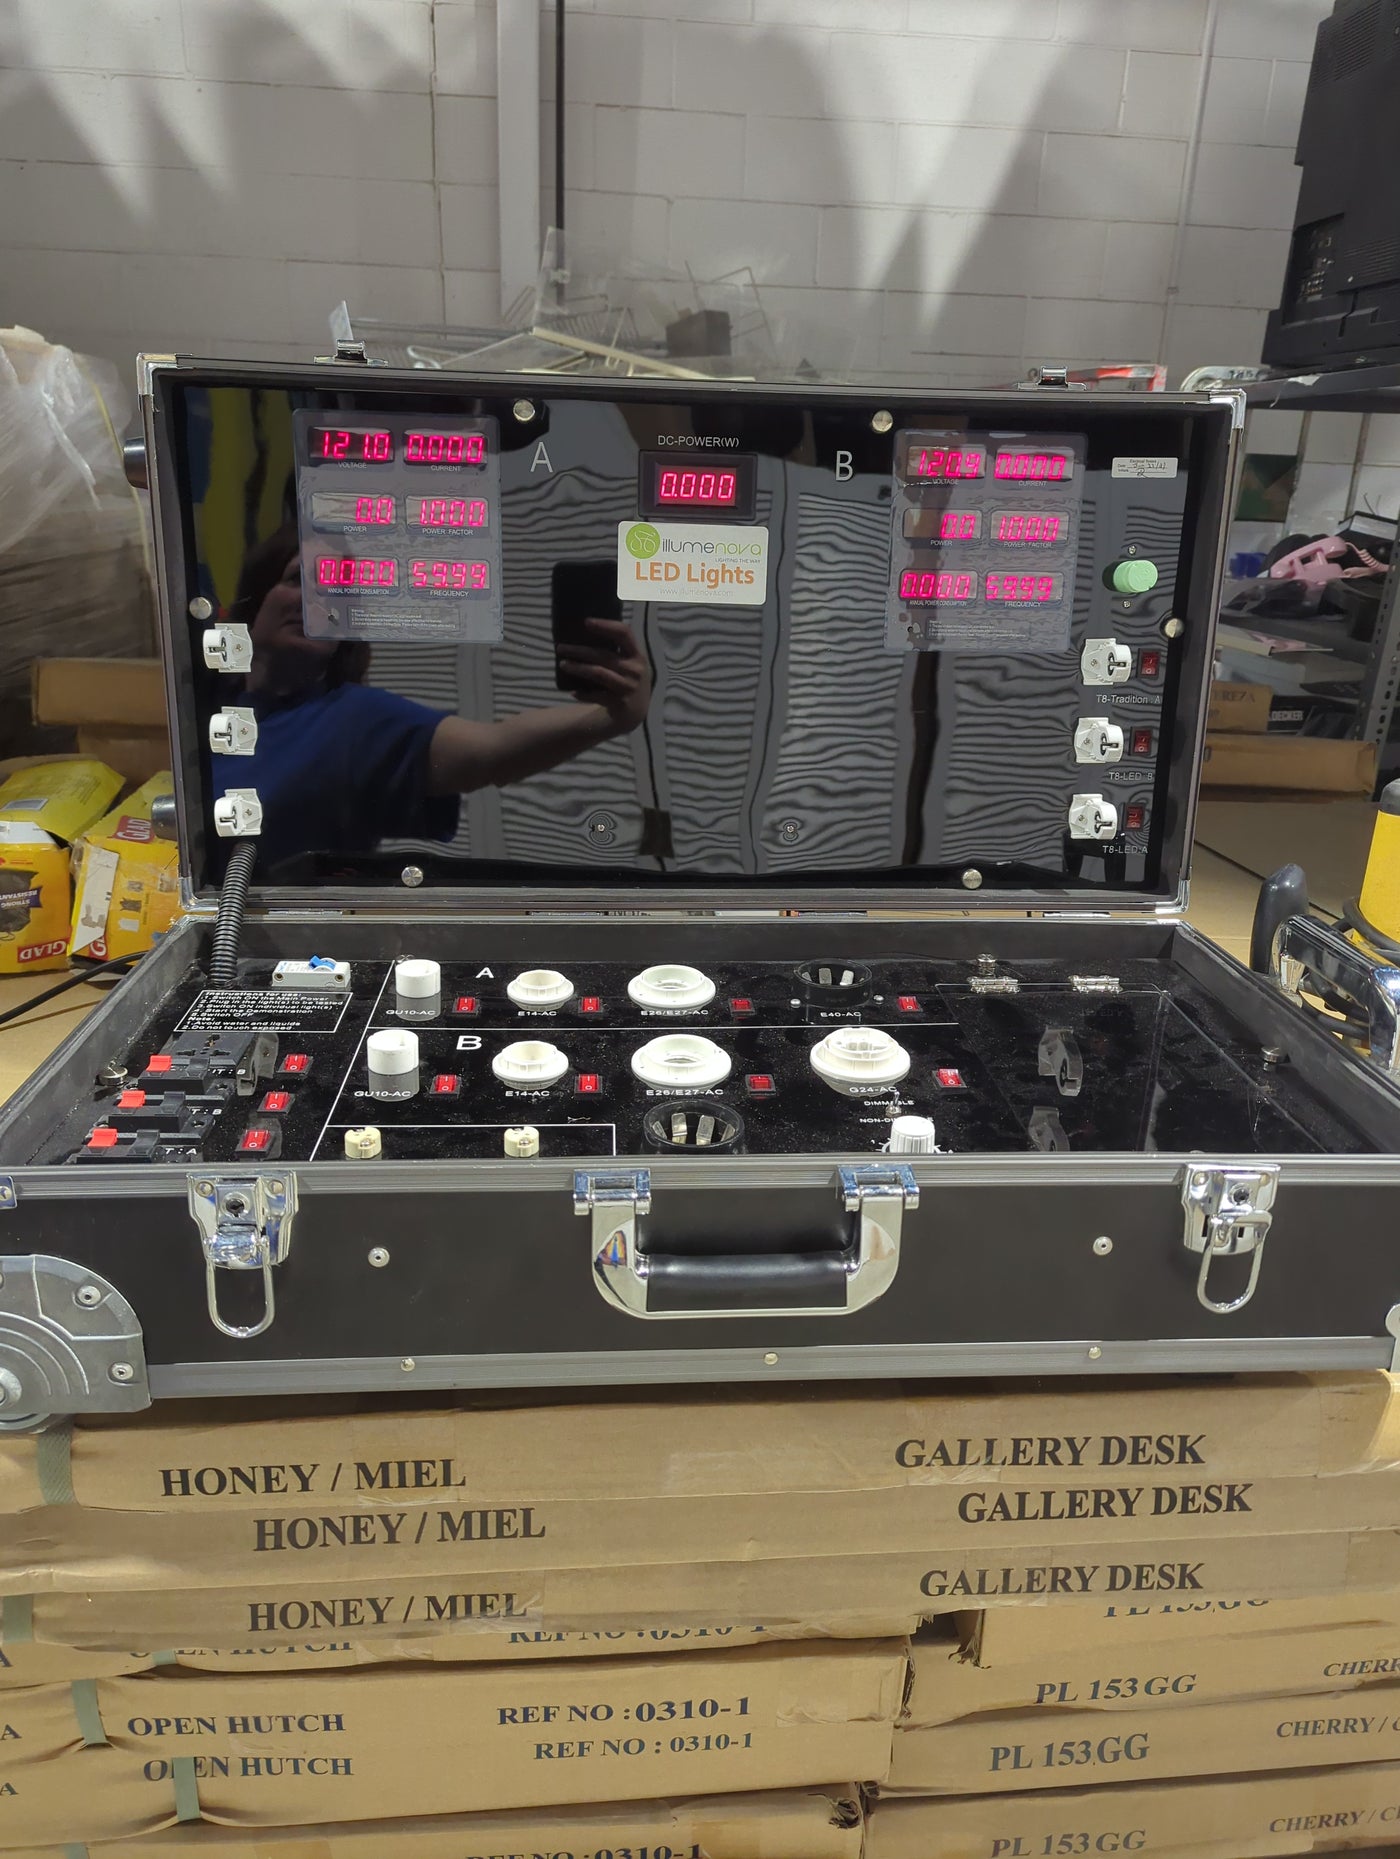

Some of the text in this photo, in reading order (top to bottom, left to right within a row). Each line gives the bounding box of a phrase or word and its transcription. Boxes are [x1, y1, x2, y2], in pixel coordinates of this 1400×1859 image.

[407, 434, 484, 463] 0.000
[657, 435, 740, 448] DC-POWER(W)
[530, 442, 553, 473] A
[835, 451, 855, 481] B
[994, 453, 1066, 480] 0.000
[660, 472, 736, 499] 0.000
[356, 497, 393, 524] 0.0
[420, 499, 485, 527] 1.000
[941, 514, 976, 539] 0.0
[999, 516, 1060, 541] 1.000
[662, 538, 762, 556] illumenova
[320, 559, 395, 586] 0.000
[413, 562, 487, 589] 59.99
[635, 561, 755, 589] LED Lights
[430, 589, 469, 597] FREQUENCY
[901, 573, 971, 599] 0.000
[985, 575, 1053, 600] 59.99
[1005, 600, 1041, 608] FREQUENCY
[1096, 694, 1148, 704] T8-Tradition
[117, 819, 151, 841] GLAD
[20, 940, 67, 961] GLAD
[475, 967, 495, 979] A
[456, 1035, 483, 1051] B
[354, 1090, 412, 1098] GU10-AC
[895, 1434, 1207, 1469] GALLERY DESK
[159, 1459, 467, 1497] HONEY / MIEL
[957, 1482, 1254, 1523] GALLERY DESK
[253, 1507, 547, 1552] HONEY / MIEL
[919, 1562, 1205, 1598] GALLERY DESK
[248, 1592, 528, 1633] HONEY / MIEL
[1033, 1681, 1079, 1704] PL
[127, 1713, 346, 1736] OPEN HUTCH
[497, 1704, 560, 1726] REF
[567, 1703, 614, 1723] NO
[1276, 1716, 1376, 1738] CHERRY
[533, 1740, 595, 1760] REF
[600, 1738, 646, 1757] NO
[670, 1732, 753, 1753] 0310-1
[989, 1745, 1033, 1772] PL
[143, 1755, 355, 1782] OEN HUTCH
[1269, 1810, 1365, 1833] CHERRY
[991, 1836, 1032, 1858] PL
